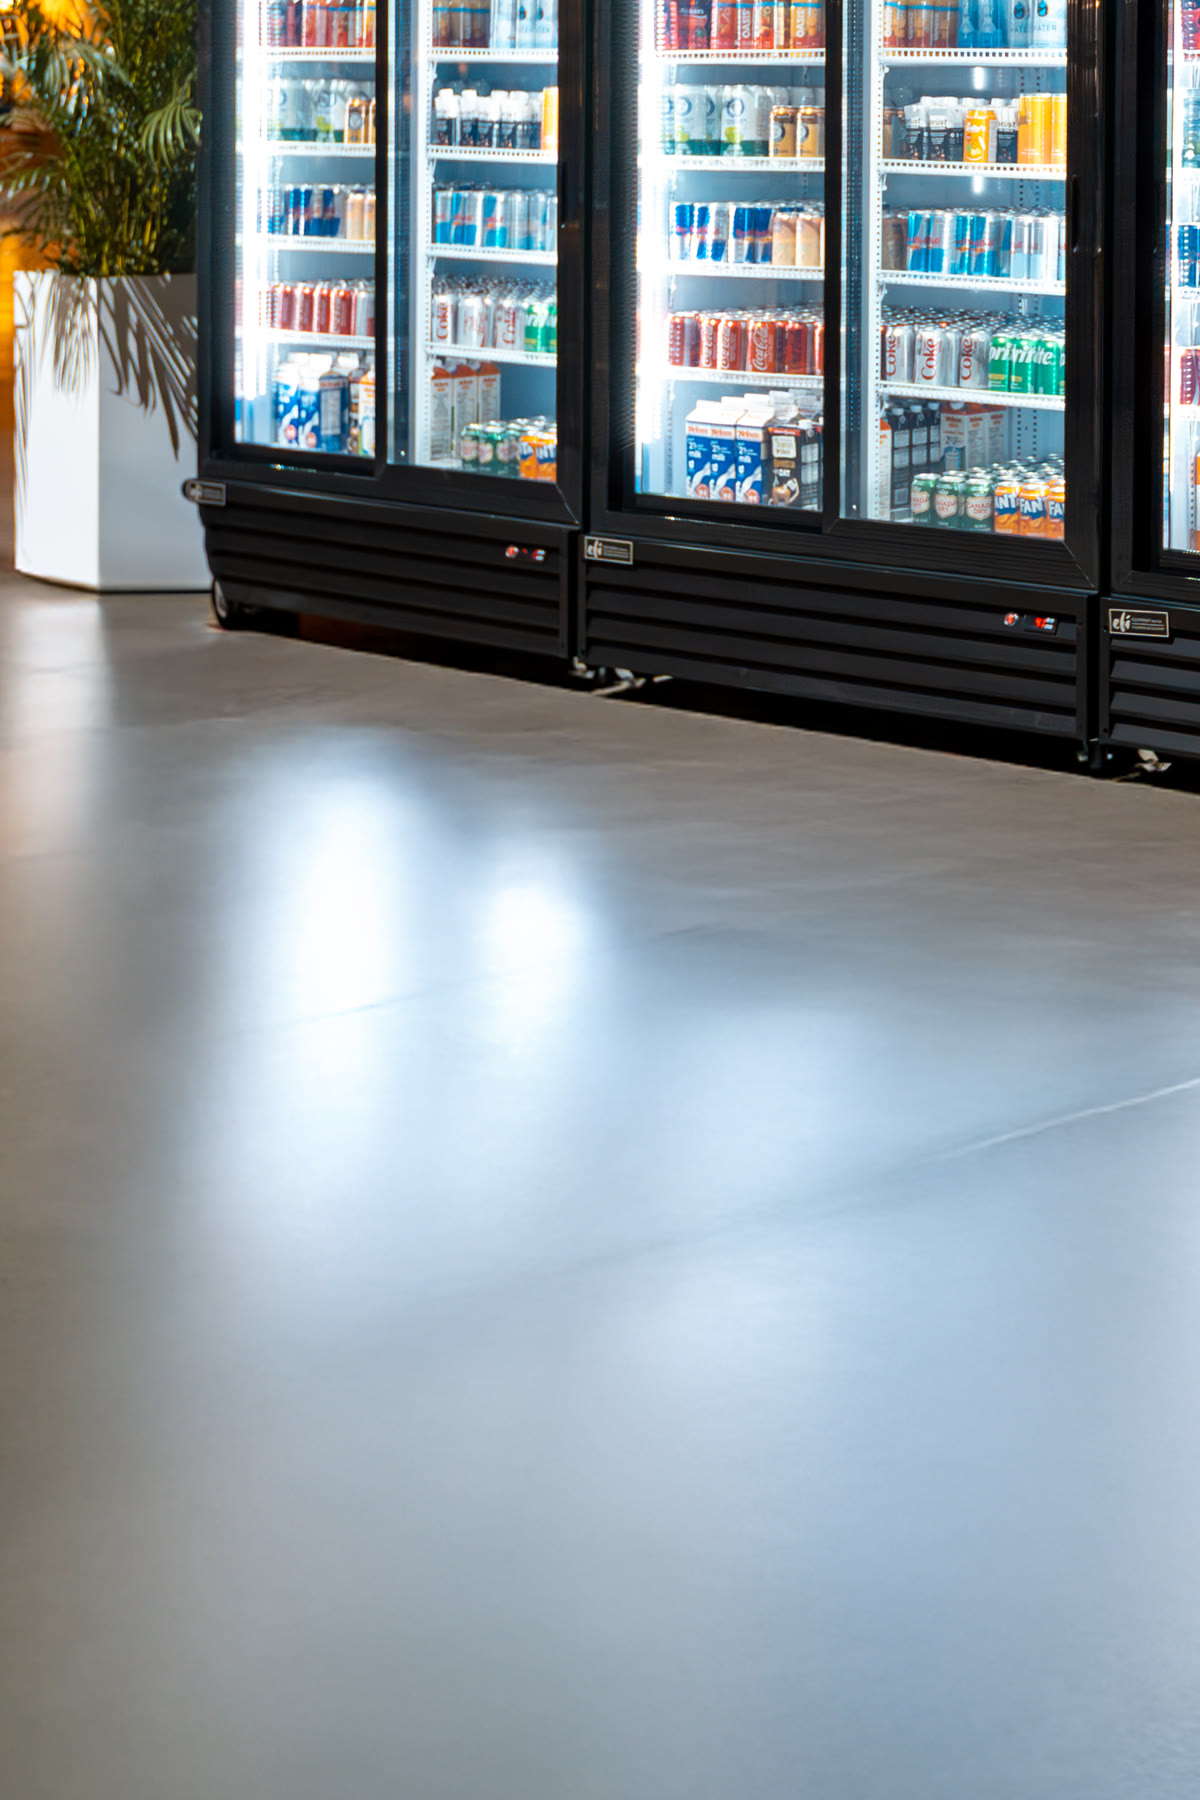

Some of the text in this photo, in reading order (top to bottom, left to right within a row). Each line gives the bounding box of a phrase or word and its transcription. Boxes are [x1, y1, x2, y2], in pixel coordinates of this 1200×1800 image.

[435, 302, 449, 340] Coke
[885, 334, 897, 377] Coke
[920, 338, 937, 380] Coke
[960, 338, 973, 381] Coke
